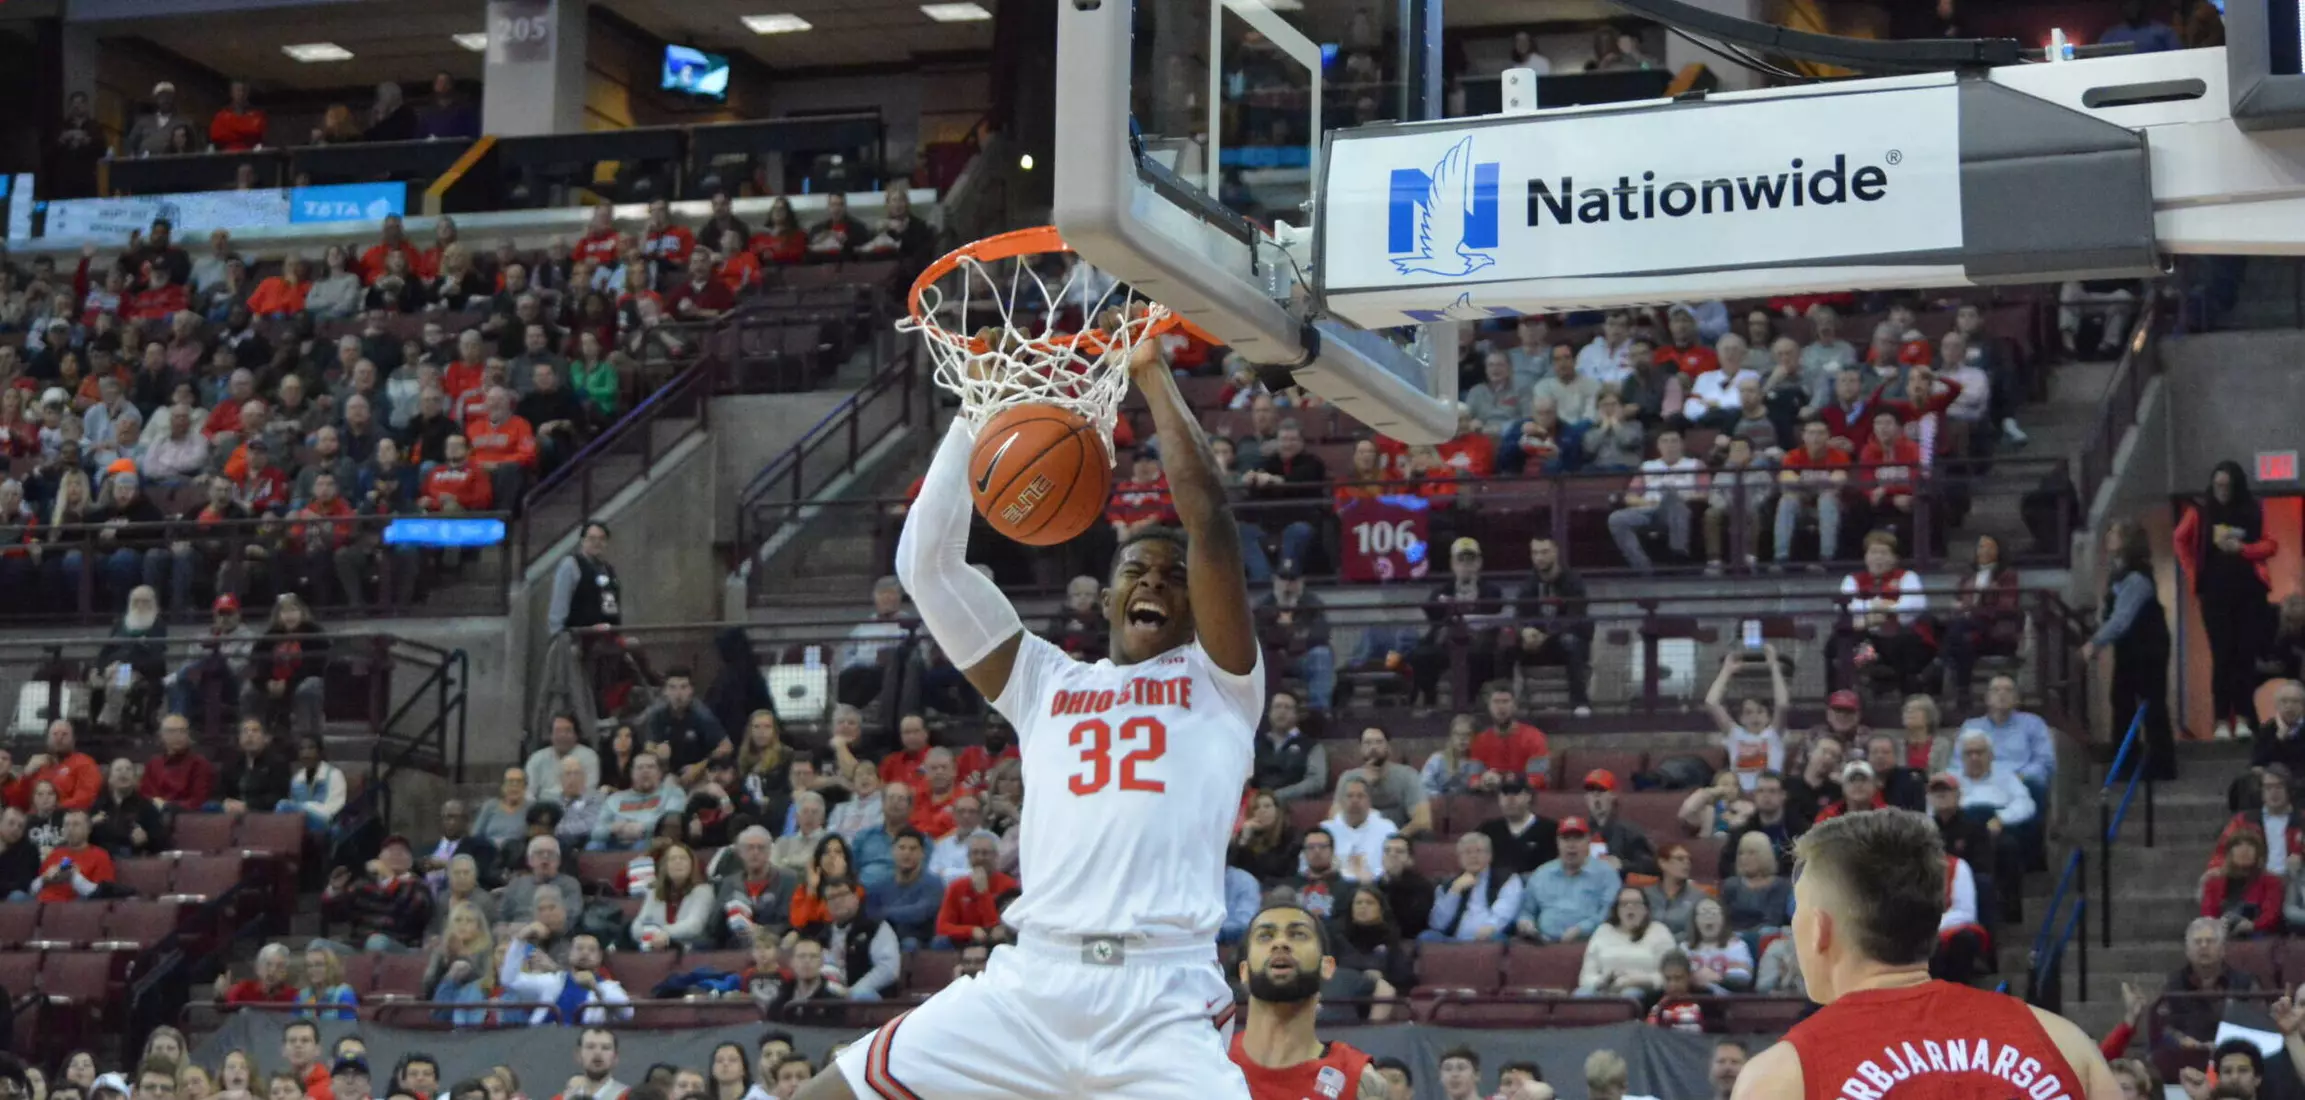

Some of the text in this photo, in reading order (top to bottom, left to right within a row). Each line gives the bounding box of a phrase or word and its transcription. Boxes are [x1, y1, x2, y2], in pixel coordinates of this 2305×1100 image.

[497, 15, 546, 42] 205
[1001, 473, 1055, 527] ELITE
[1351, 519, 1418, 556] 106
[1051, 676, 1193, 717] OHIO STATE
[1068, 715, 1167, 797] 32
[1834, 1037, 2072, 1100] RBJARNARSO
